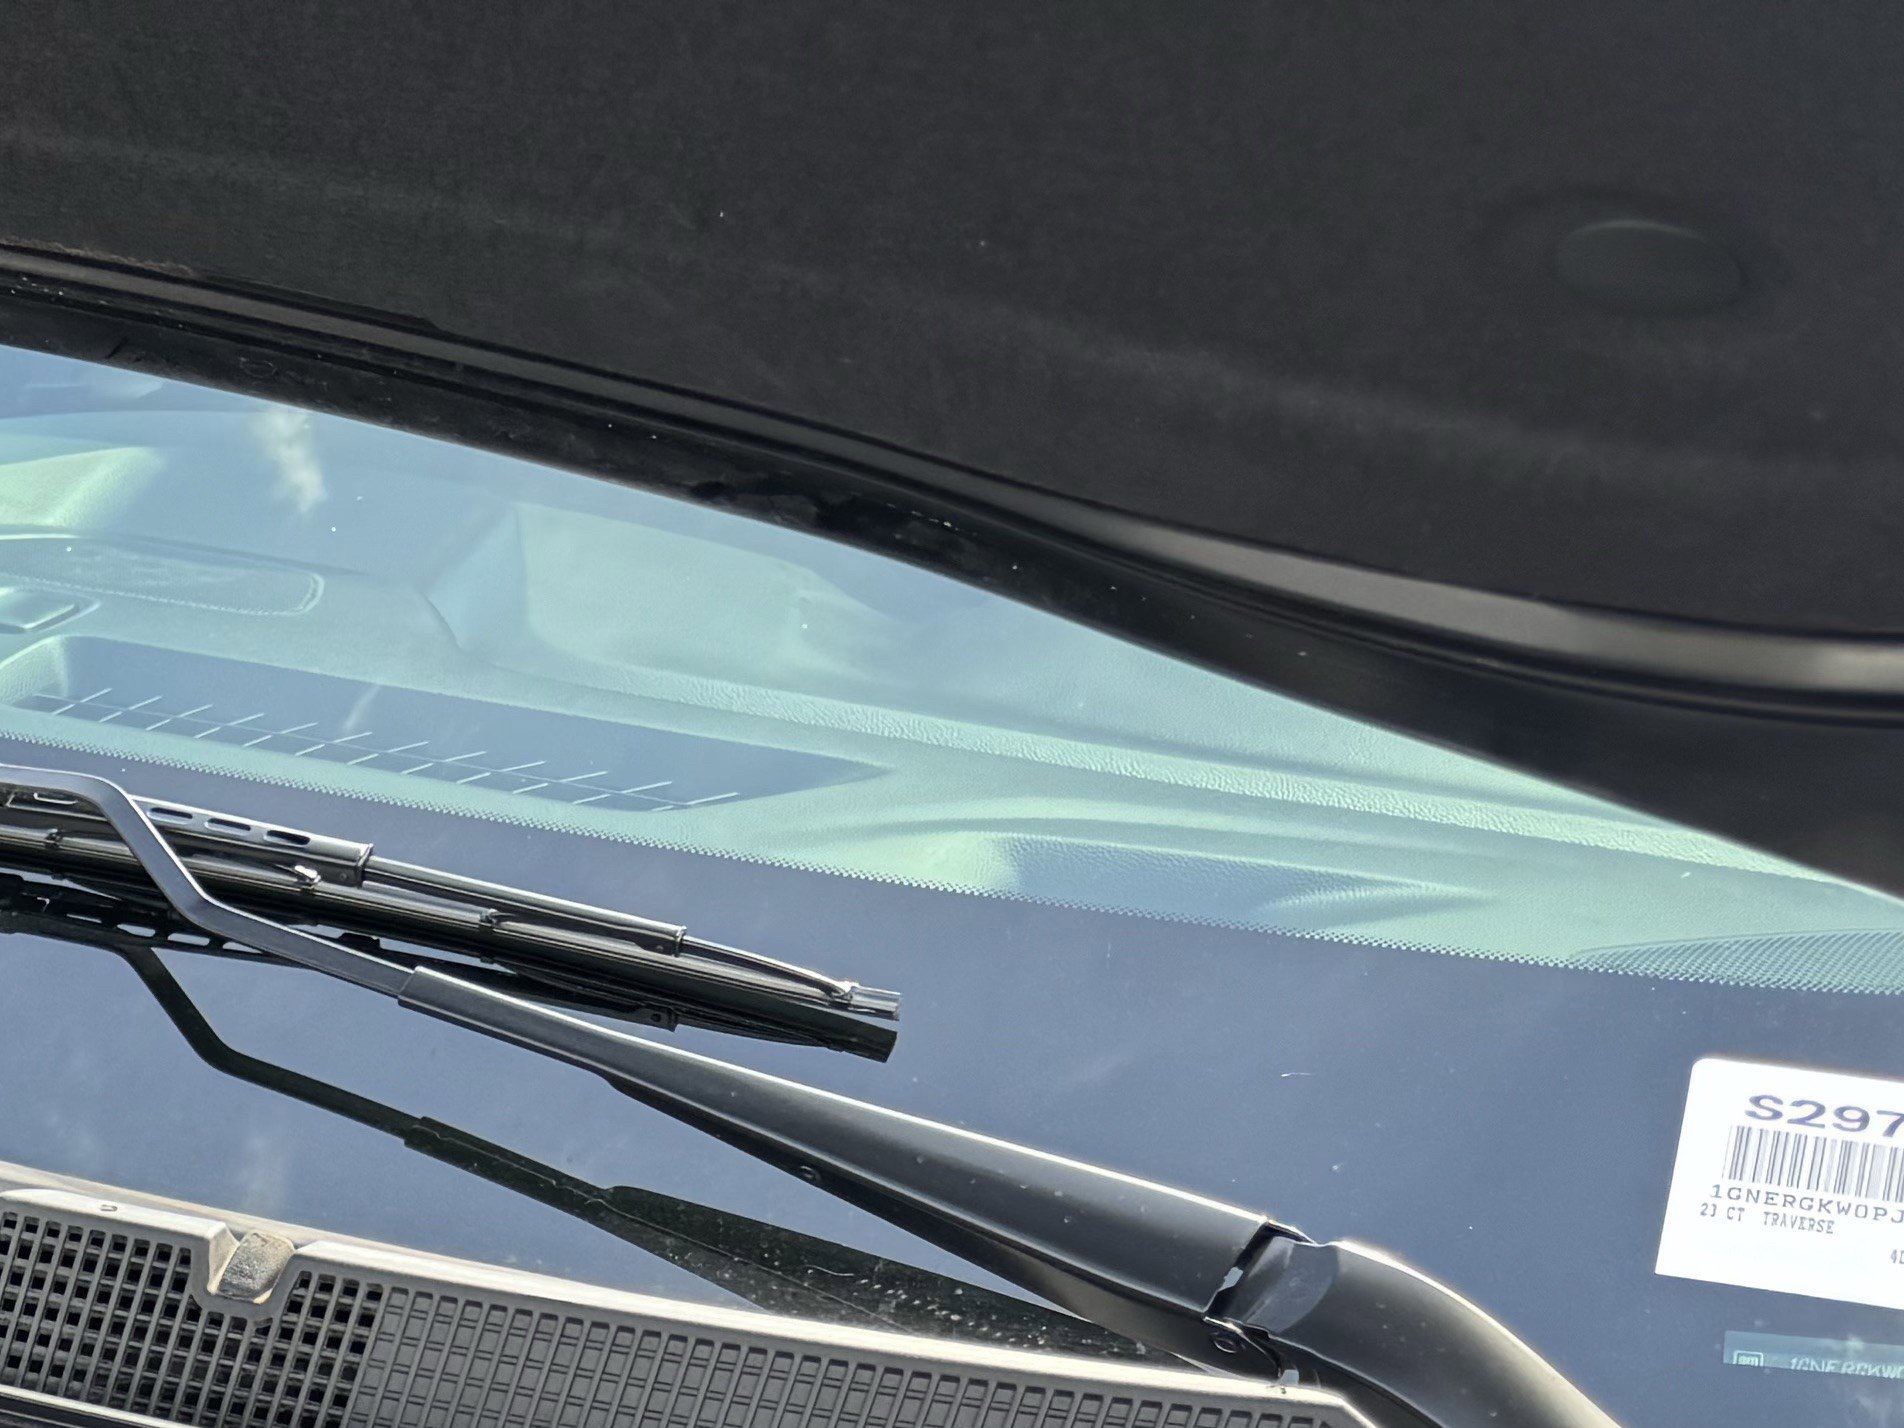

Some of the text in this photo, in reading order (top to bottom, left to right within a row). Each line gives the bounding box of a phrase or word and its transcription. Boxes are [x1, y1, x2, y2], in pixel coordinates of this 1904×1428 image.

[1744, 1094, 1904, 1138] S297
[1727, 1206, 1745, 1222] CT
[1763, 1212, 1836, 1234] TRAVERSE
